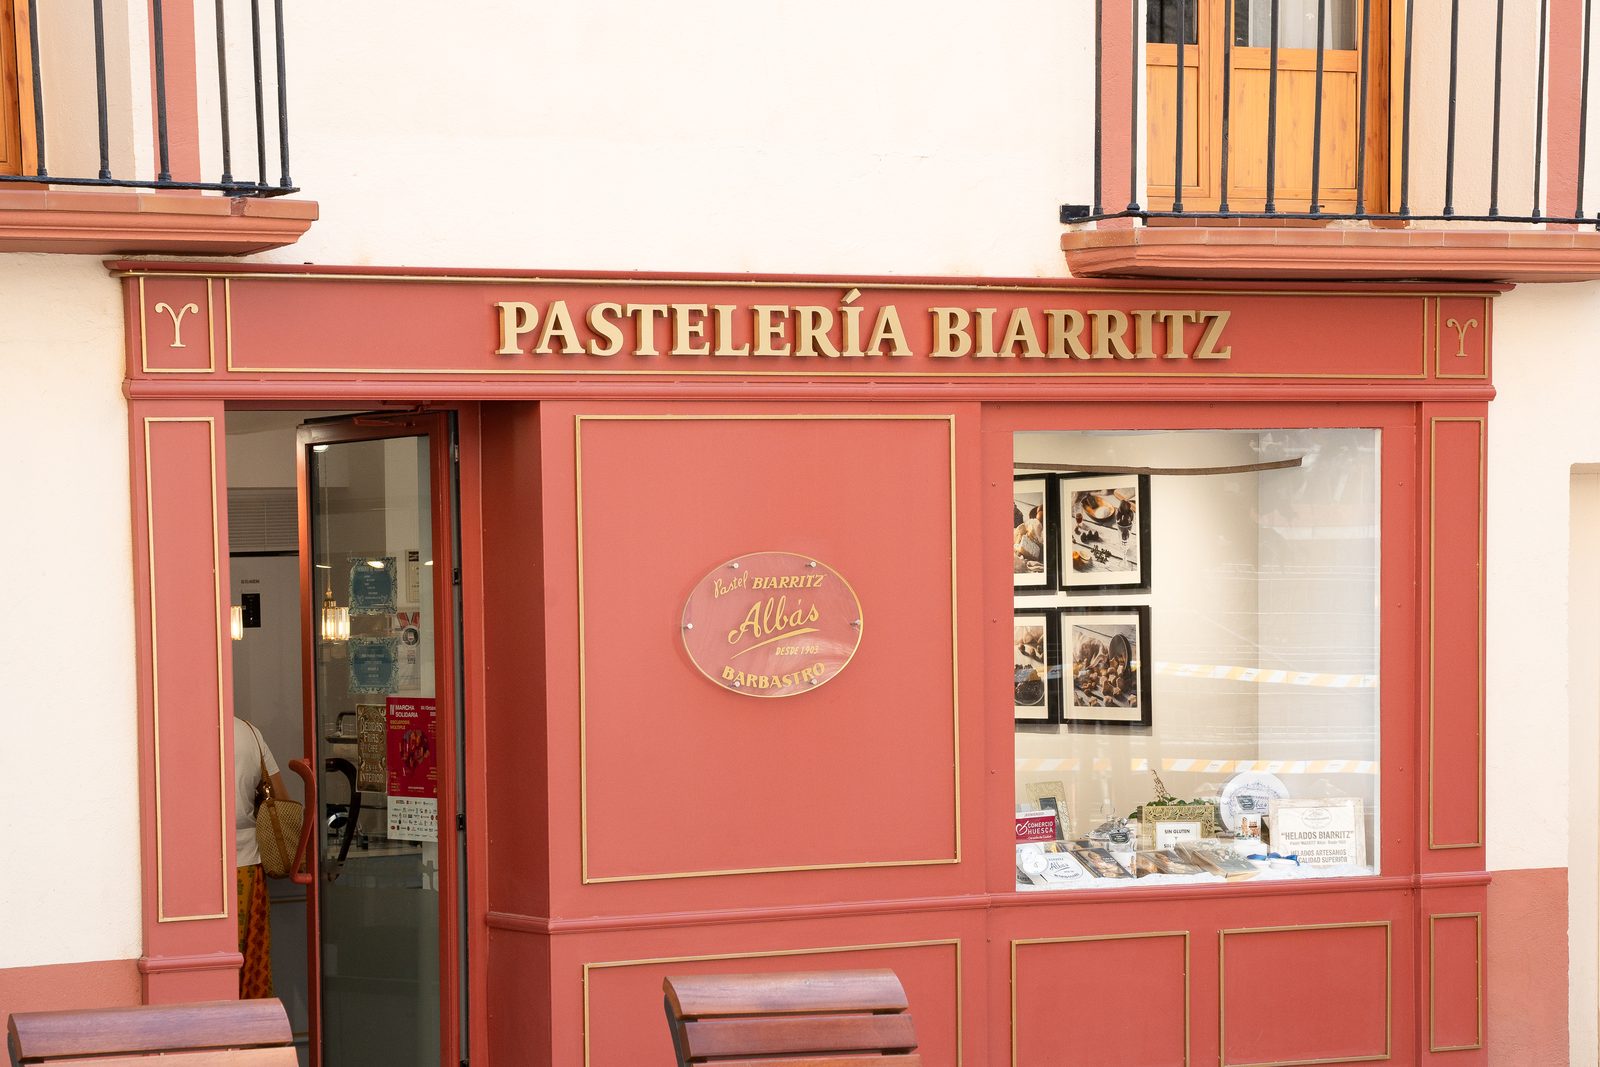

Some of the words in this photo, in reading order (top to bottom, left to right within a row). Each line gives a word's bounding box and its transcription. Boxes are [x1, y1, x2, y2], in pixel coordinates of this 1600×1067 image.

[494, 287, 913, 359] PASTELERÍA
[927, 305, 1232, 361] BIARRITZ
[713, 570, 748, 598] Pastel
[727, 595, 819, 645] Albás
[775, 646, 799, 656] DESDE
[800, 645, 819, 655] 1903
[721, 662, 826, 689] BARBASTRO
[1027, 821, 1053, 829] COMERCIO
[1027, 827, 1053, 835] HUESCA
[1316, 848, 1347, 856] ARTESANOS
[1298, 855, 1321, 864] CALIDAD
[1321, 855, 1348, 863] SUPERIOR
